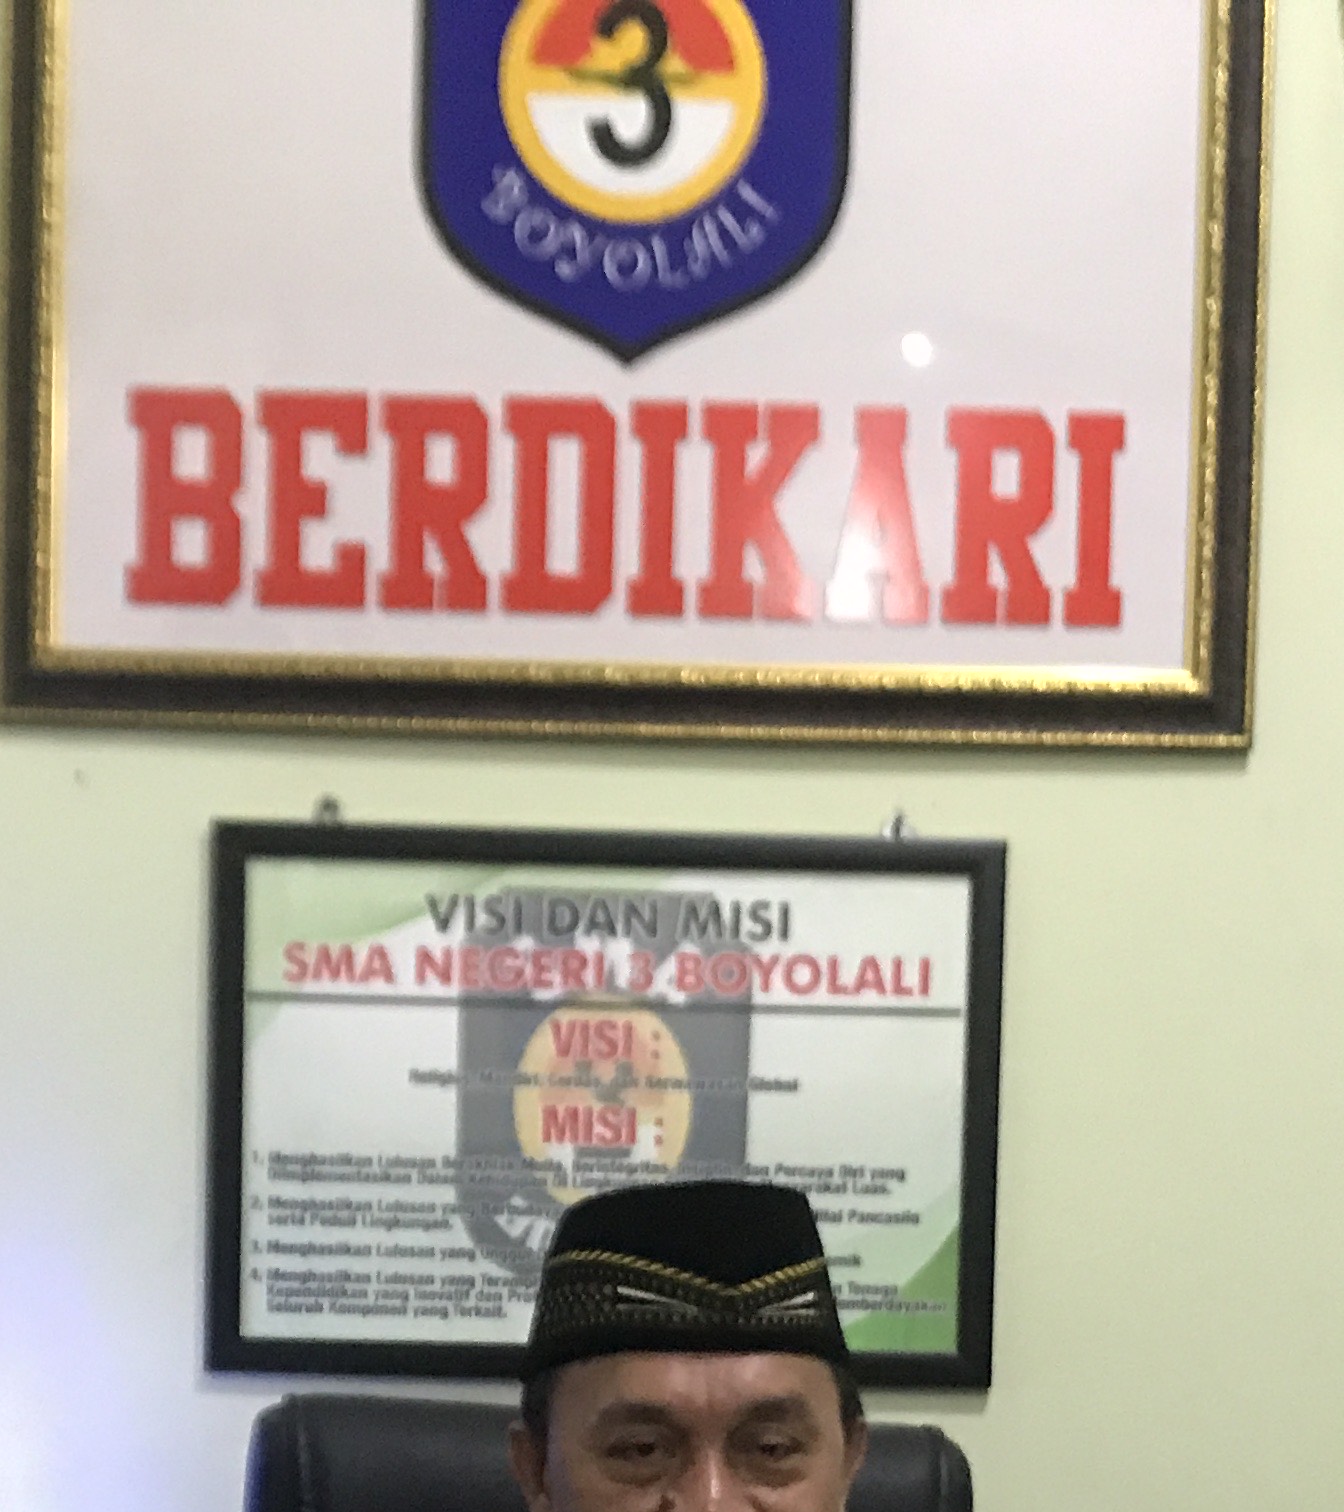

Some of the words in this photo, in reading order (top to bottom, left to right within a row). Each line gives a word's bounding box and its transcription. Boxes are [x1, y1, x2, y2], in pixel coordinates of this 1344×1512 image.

[585, 0, 672, 167] 3
[480, 160, 781, 293] BOYOLALI
[123, 384, 1125, 628] BERDIKARI
[424, 892, 523, 937] VISI
[546, 896, 657, 938] DAN
[675, 897, 791, 943] MISI
[282, 940, 396, 985] SMA
[413, 943, 605, 990] NEGERI
[627, 951, 655, 992] 3
[674, 951, 932, 997] BOYOLALI
[550, 1018, 634, 1060] VISI
[542, 1104, 637, 1147] MISI
